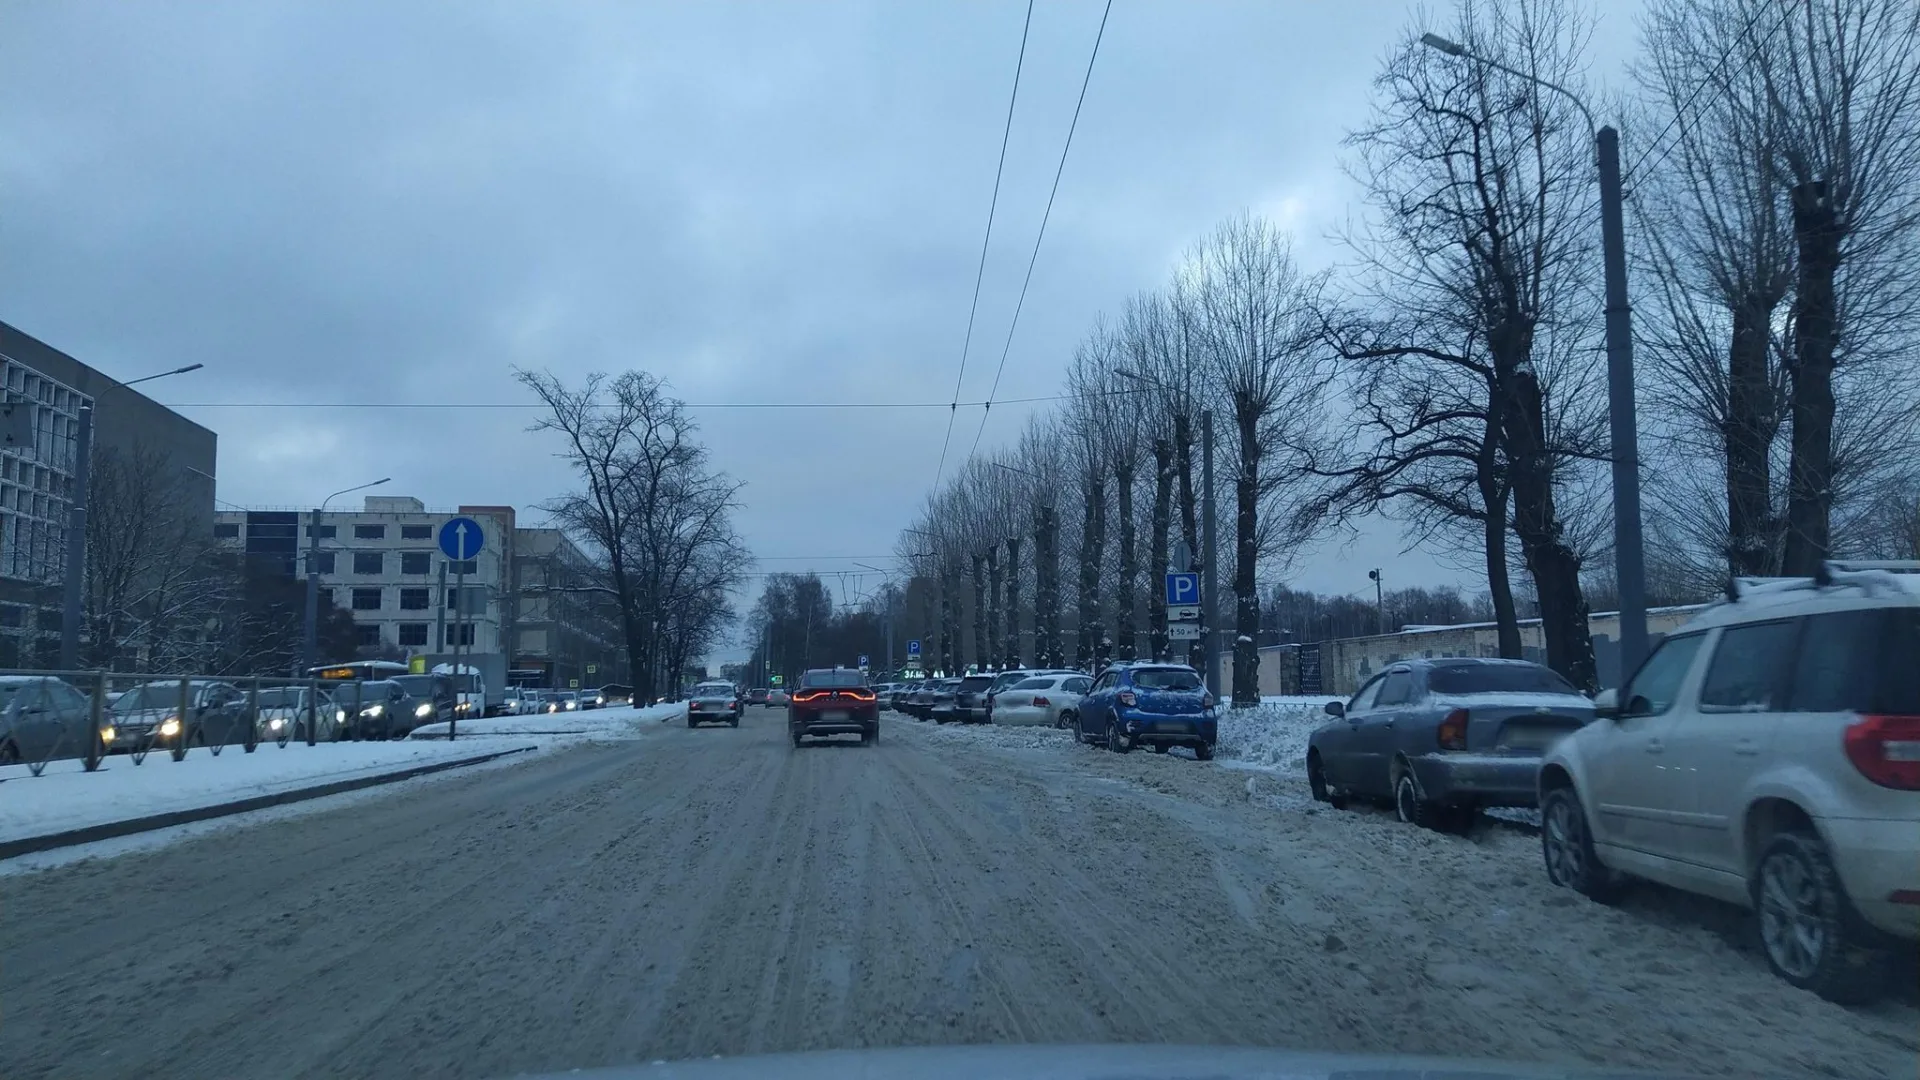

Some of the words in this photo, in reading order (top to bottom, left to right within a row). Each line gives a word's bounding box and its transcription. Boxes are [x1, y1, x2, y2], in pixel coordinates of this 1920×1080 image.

[1174, 576, 1193, 601] P
[910, 641, 919, 653] P
[860, 656, 867, 665] P
